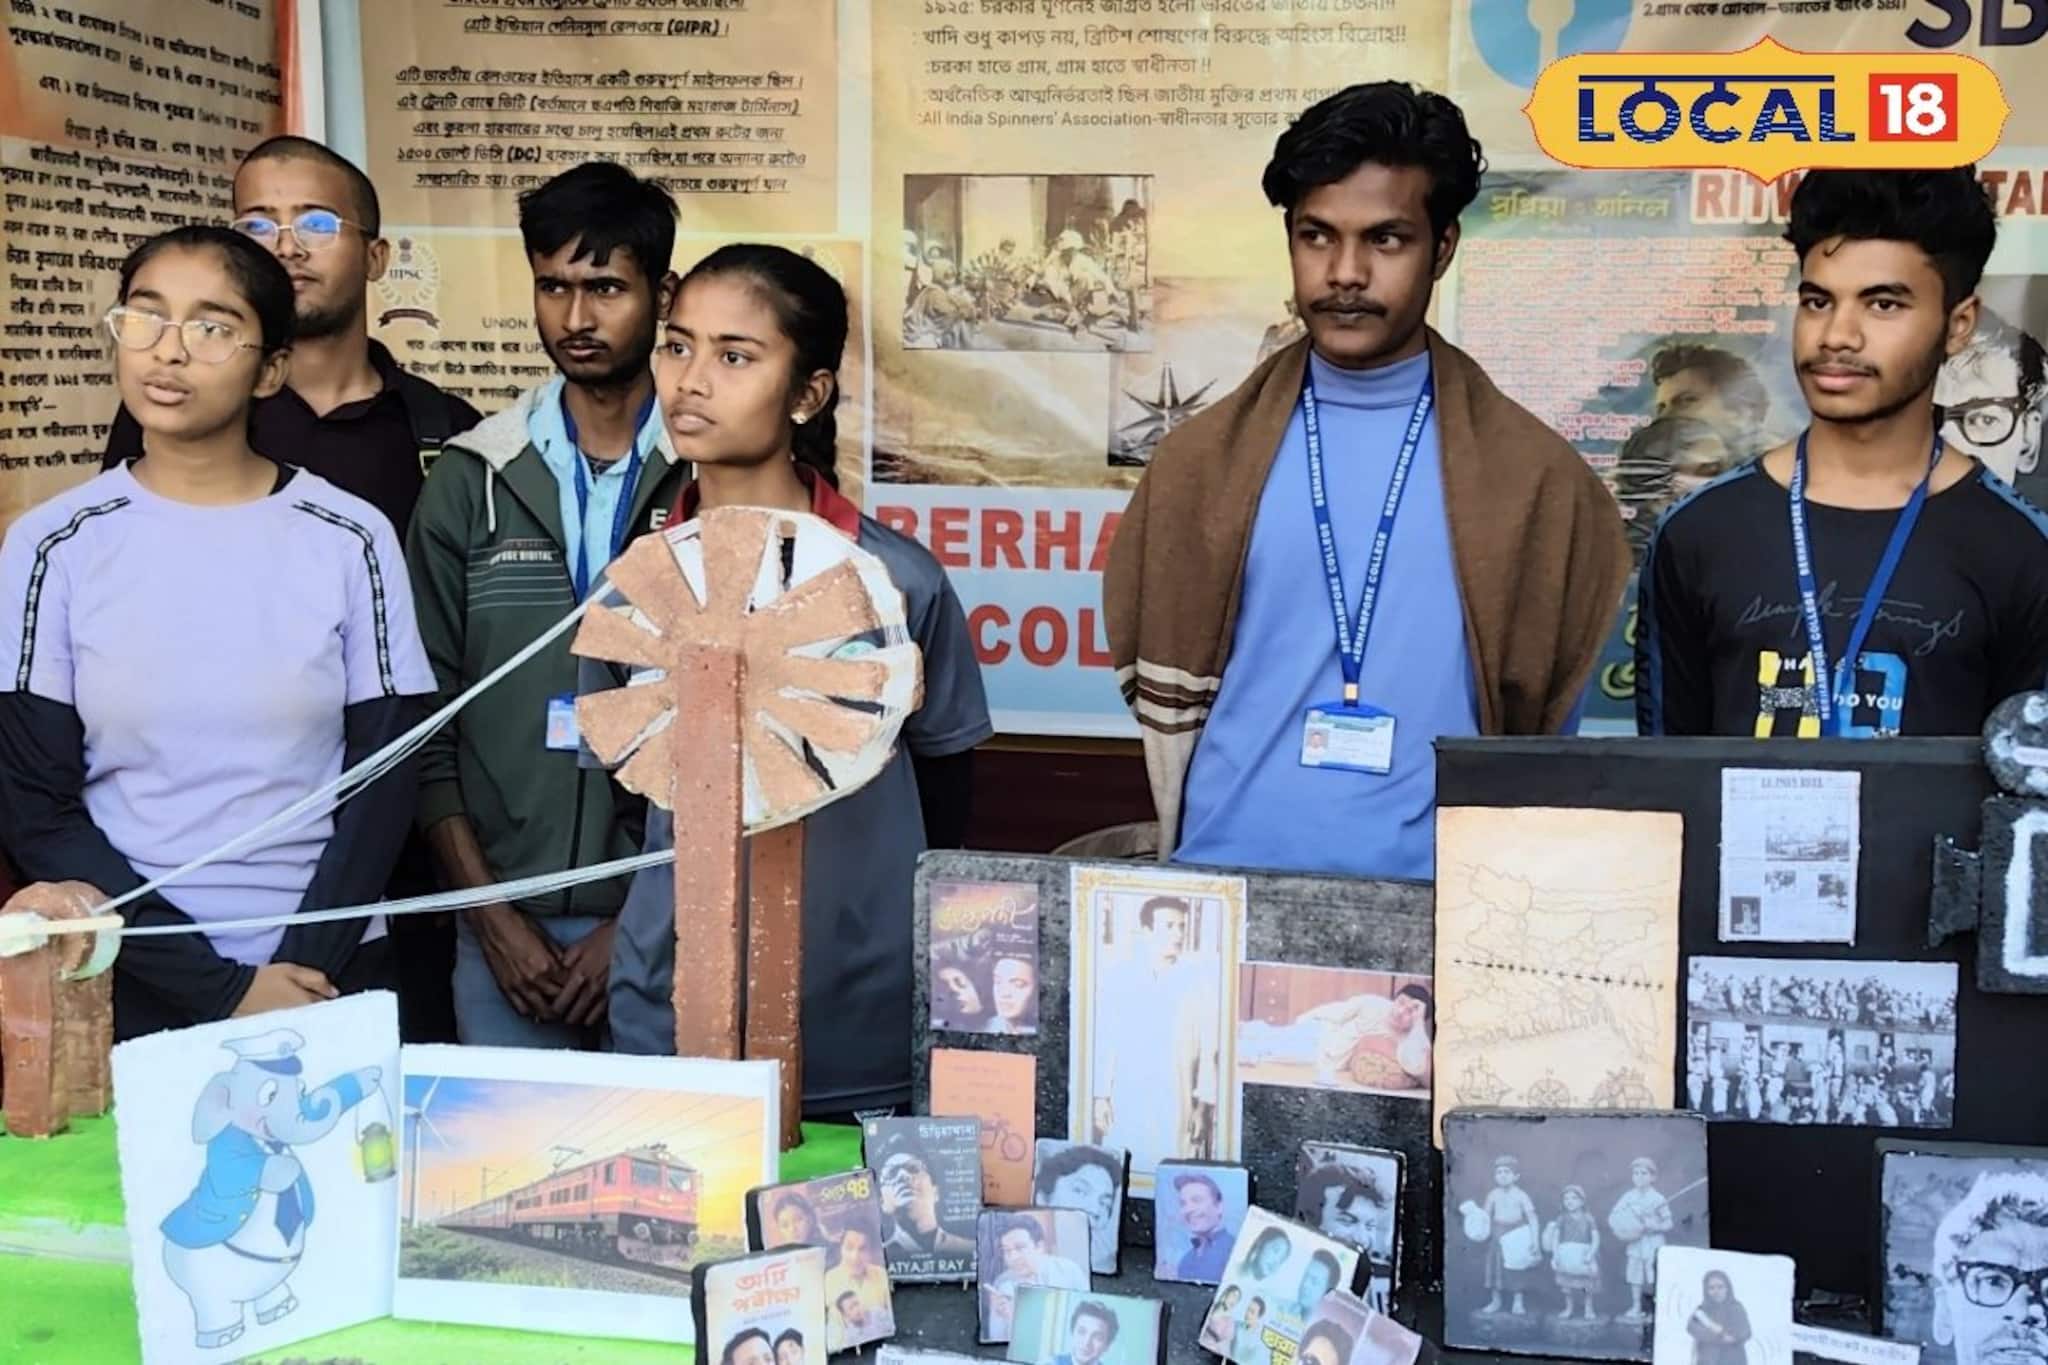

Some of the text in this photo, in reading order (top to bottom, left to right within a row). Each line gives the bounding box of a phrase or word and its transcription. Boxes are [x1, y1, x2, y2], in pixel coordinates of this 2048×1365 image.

[946, 112, 983, 125] India
[507, 145, 541, 163] (DC)
[482, 317, 528, 329] UNION
[1384, 395, 1431, 517] BERHAMPORE COLLEGE
[1368, 532, 1388, 584] COLLEGE
[1319, 523, 1351, 654] BERHAMPORE COLLEGE
[1803, 591, 1821, 642] COLLEGE
[1865, 694, 1903, 711] YOU
[938, 1259, 965, 1272] RAY
